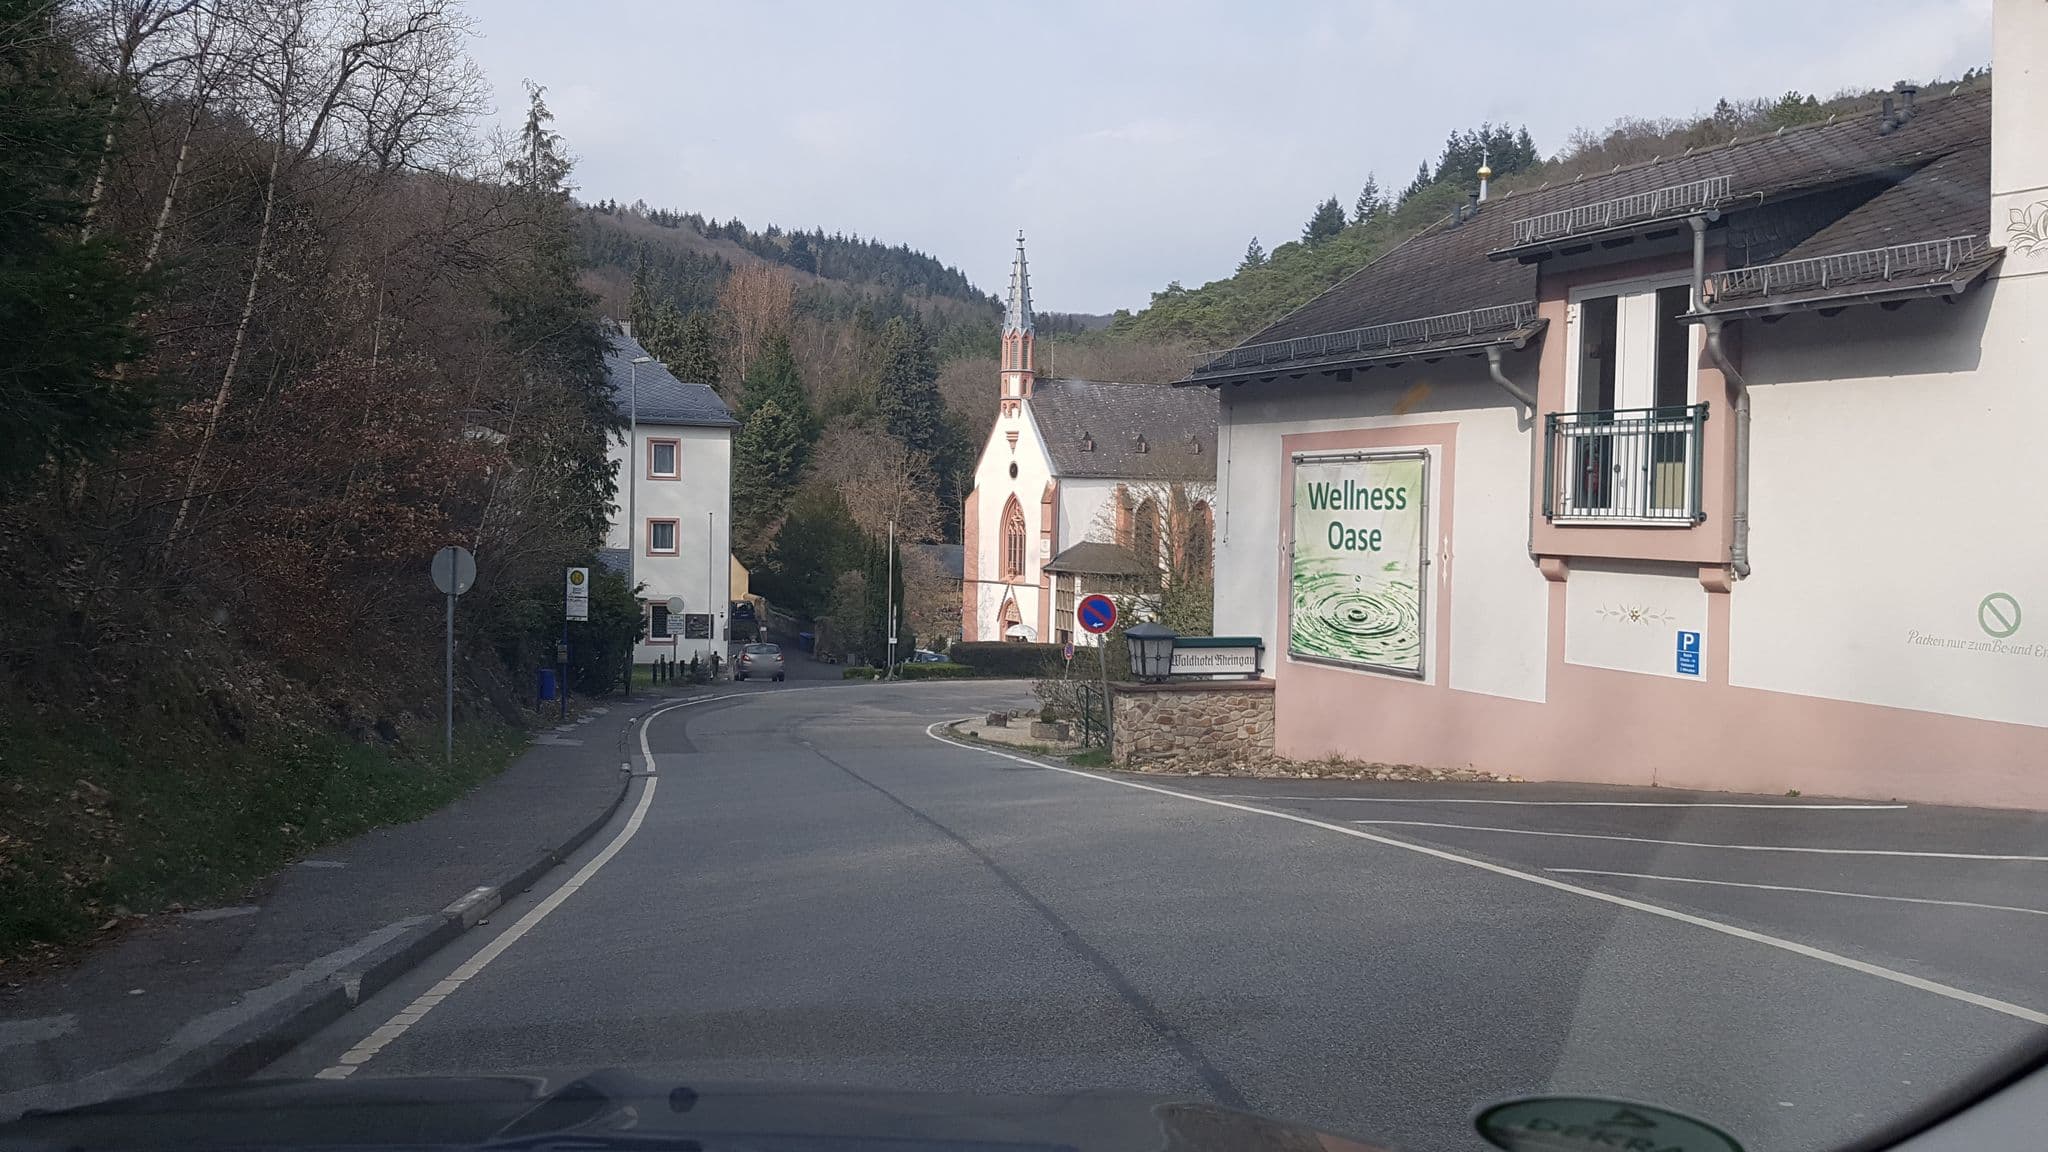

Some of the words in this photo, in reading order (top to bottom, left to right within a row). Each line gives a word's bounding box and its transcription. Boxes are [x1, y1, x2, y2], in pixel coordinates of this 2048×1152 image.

[1307, 479, 1407, 510] Wellness
[1328, 520, 1382, 552] Oase
[1683, 632, 1695, 651] P
[1907, 629, 1945, 648] Parken
[1946, 639, 1967, 649] nur
[1967, 640, 1992, 652] zum
[1172, 654, 1214, 667] Waldhotel
[1214, 654, 1256, 667] Rheingau
